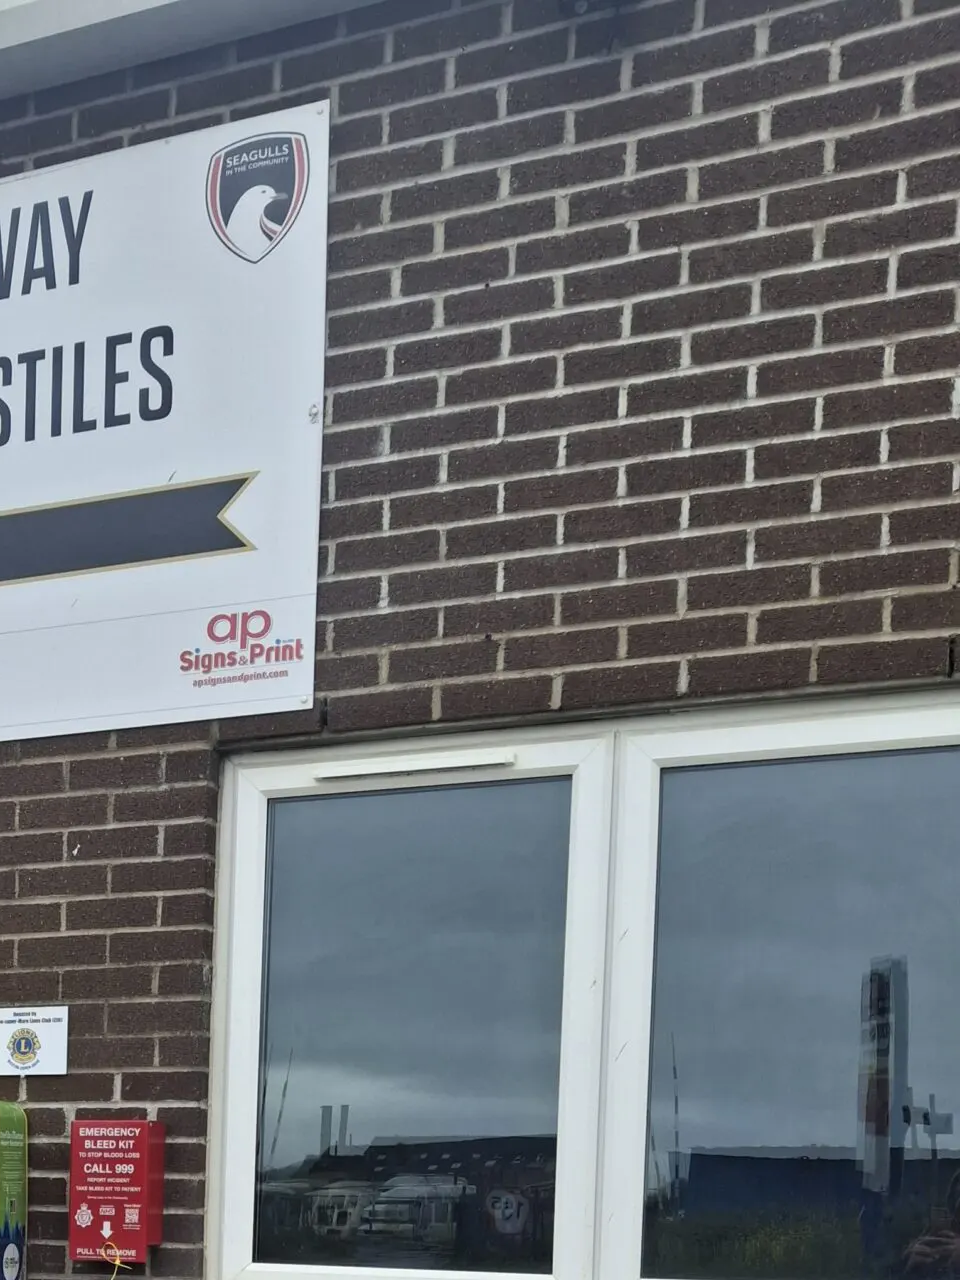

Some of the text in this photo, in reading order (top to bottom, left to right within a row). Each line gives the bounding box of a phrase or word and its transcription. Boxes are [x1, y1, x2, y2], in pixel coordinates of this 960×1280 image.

[226, 144, 289, 168] SEAGULLS
[234, 165, 246, 173] THE
[248, 156, 289, 170] COMMUNITY
[207, 610, 271, 649] ap
[192, 669, 289, 688] apsignsandprint.com
[79, 1127, 141, 1137] EMERGENCY
[84, 1140, 135, 1149] BLEED KIT
[84, 1163, 135, 1174] CALL 999
[106, 1248, 137, 1257] REMOVE
